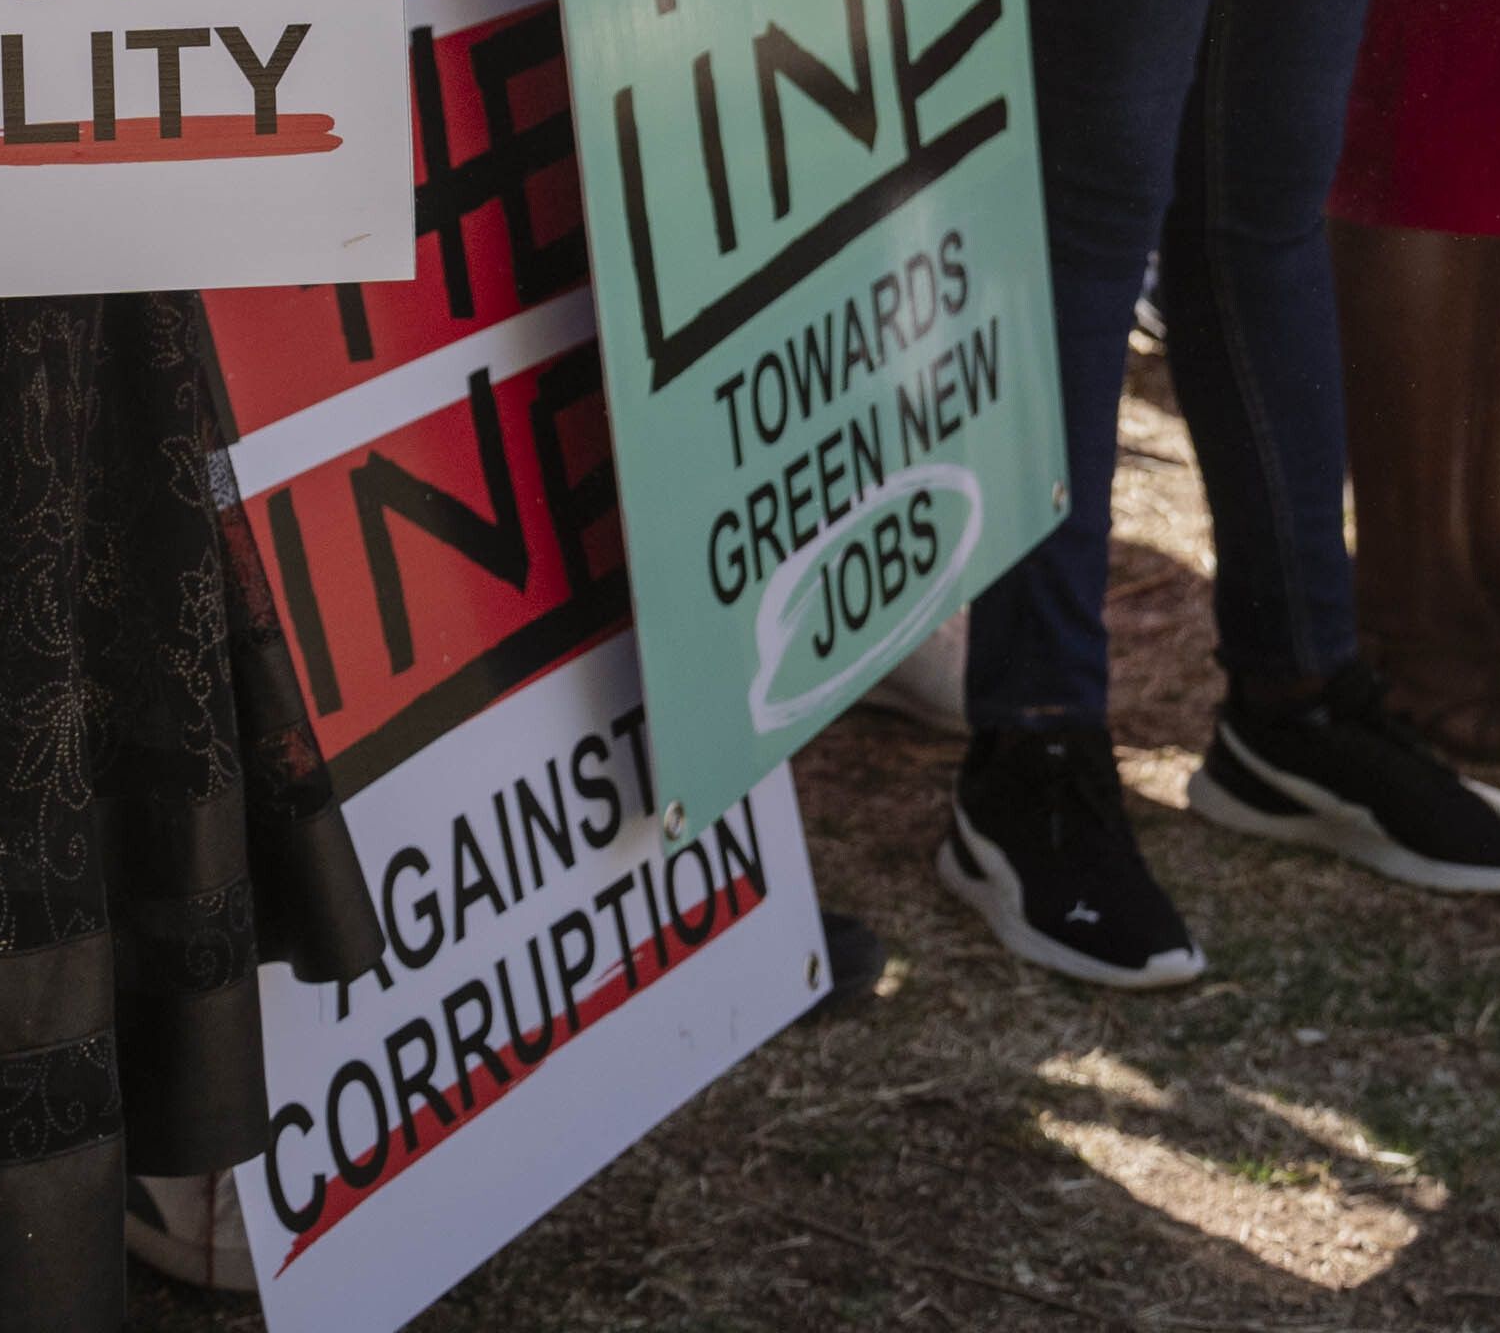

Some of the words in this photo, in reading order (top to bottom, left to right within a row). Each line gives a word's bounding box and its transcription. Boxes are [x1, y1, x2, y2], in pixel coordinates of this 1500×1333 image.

[708, 404, 885, 606] GREEN
[898, 315, 999, 467] NEW
[714, 228, 968, 468] TOWARDS
[812, 489, 938, 659] JOBS
[337, 705, 656, 1023] GAINST
[265, 794, 768, 1234] CORRUPTION
